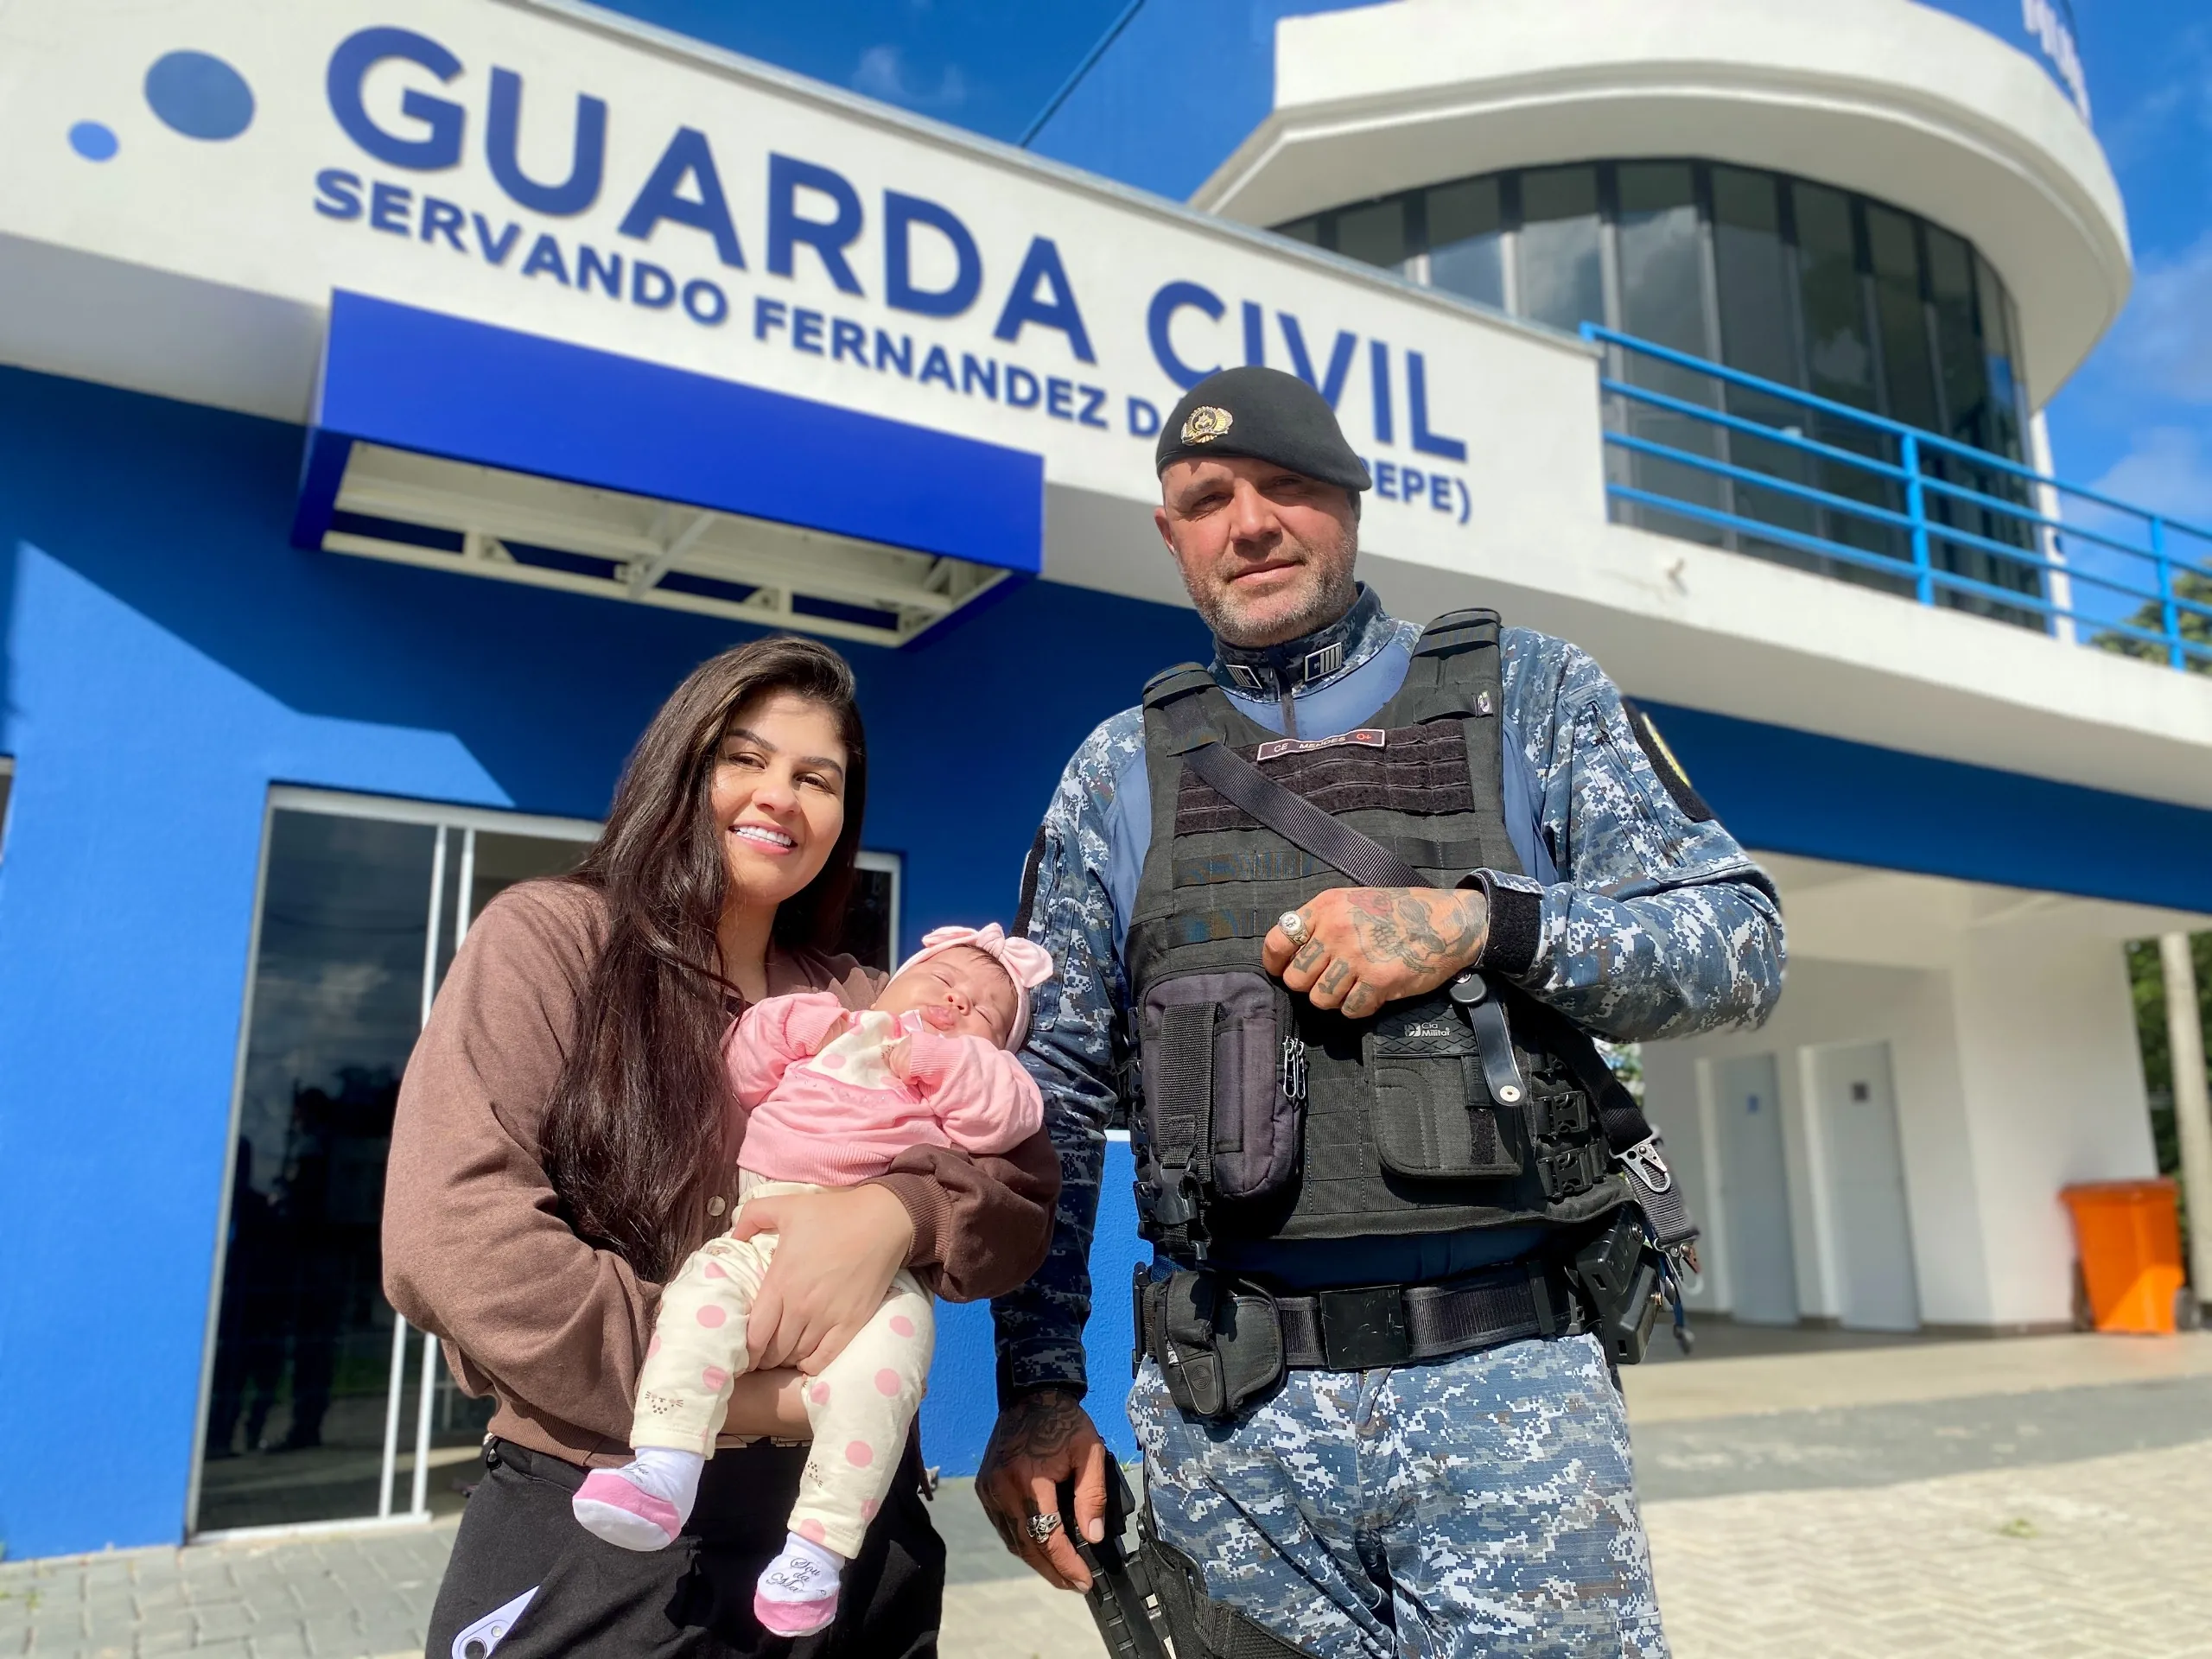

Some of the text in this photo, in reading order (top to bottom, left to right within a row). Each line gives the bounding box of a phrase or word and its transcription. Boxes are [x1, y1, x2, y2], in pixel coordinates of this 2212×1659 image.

[325, 24, 1468, 463] GUARDA CIVIL
[313, 168, 730, 327] SERVANDO
[754, 296, 1109, 429] FERNANDEZ
[1299, 736, 1346, 749] MENDES
[1421, 1027, 1451, 1037] Militar
[791, 1557, 821, 1576] Sou
[792, 1572, 810, 1582] da
